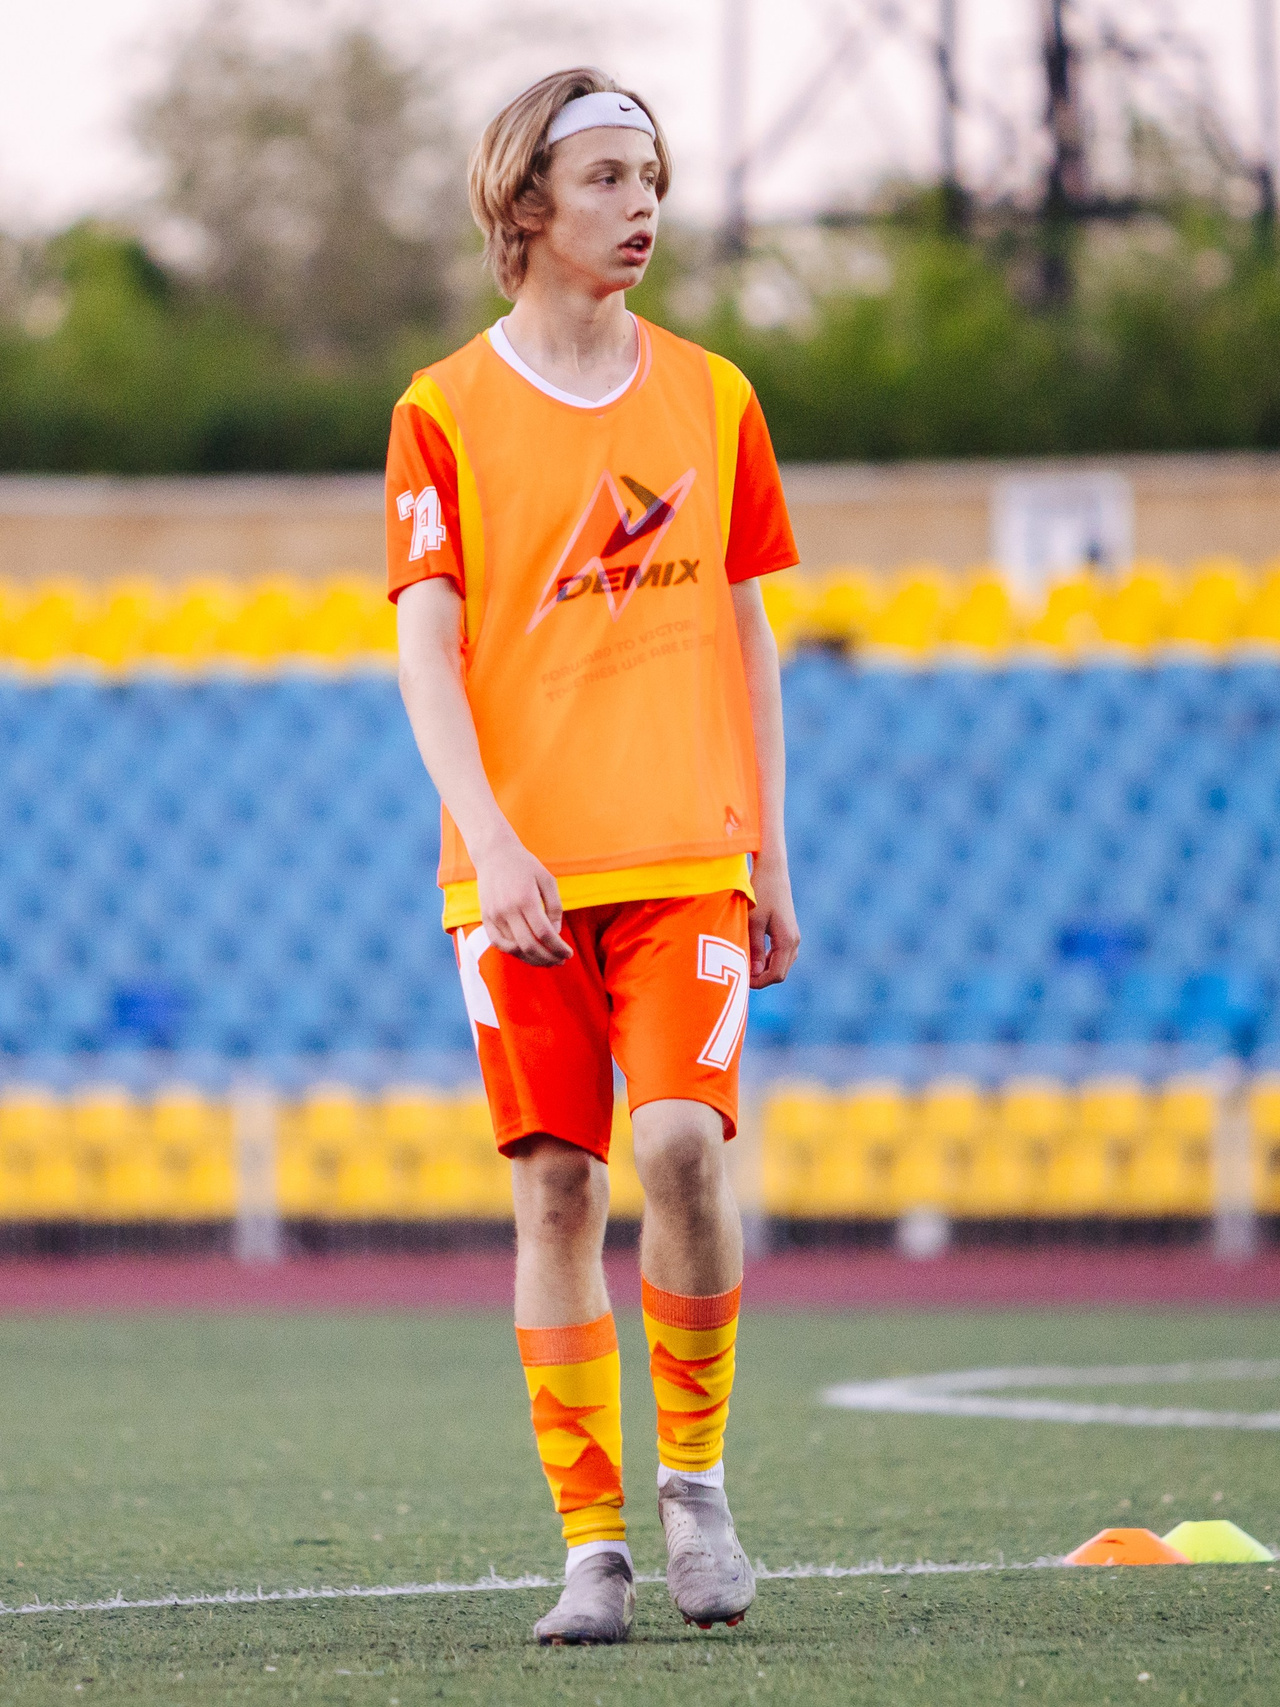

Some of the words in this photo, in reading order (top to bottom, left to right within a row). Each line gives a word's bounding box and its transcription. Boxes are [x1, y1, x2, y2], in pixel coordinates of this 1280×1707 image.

[556, 559, 700, 602] DEMIX
[615, 638, 636, 653] TO
[696, 933, 750, 1072] 7
